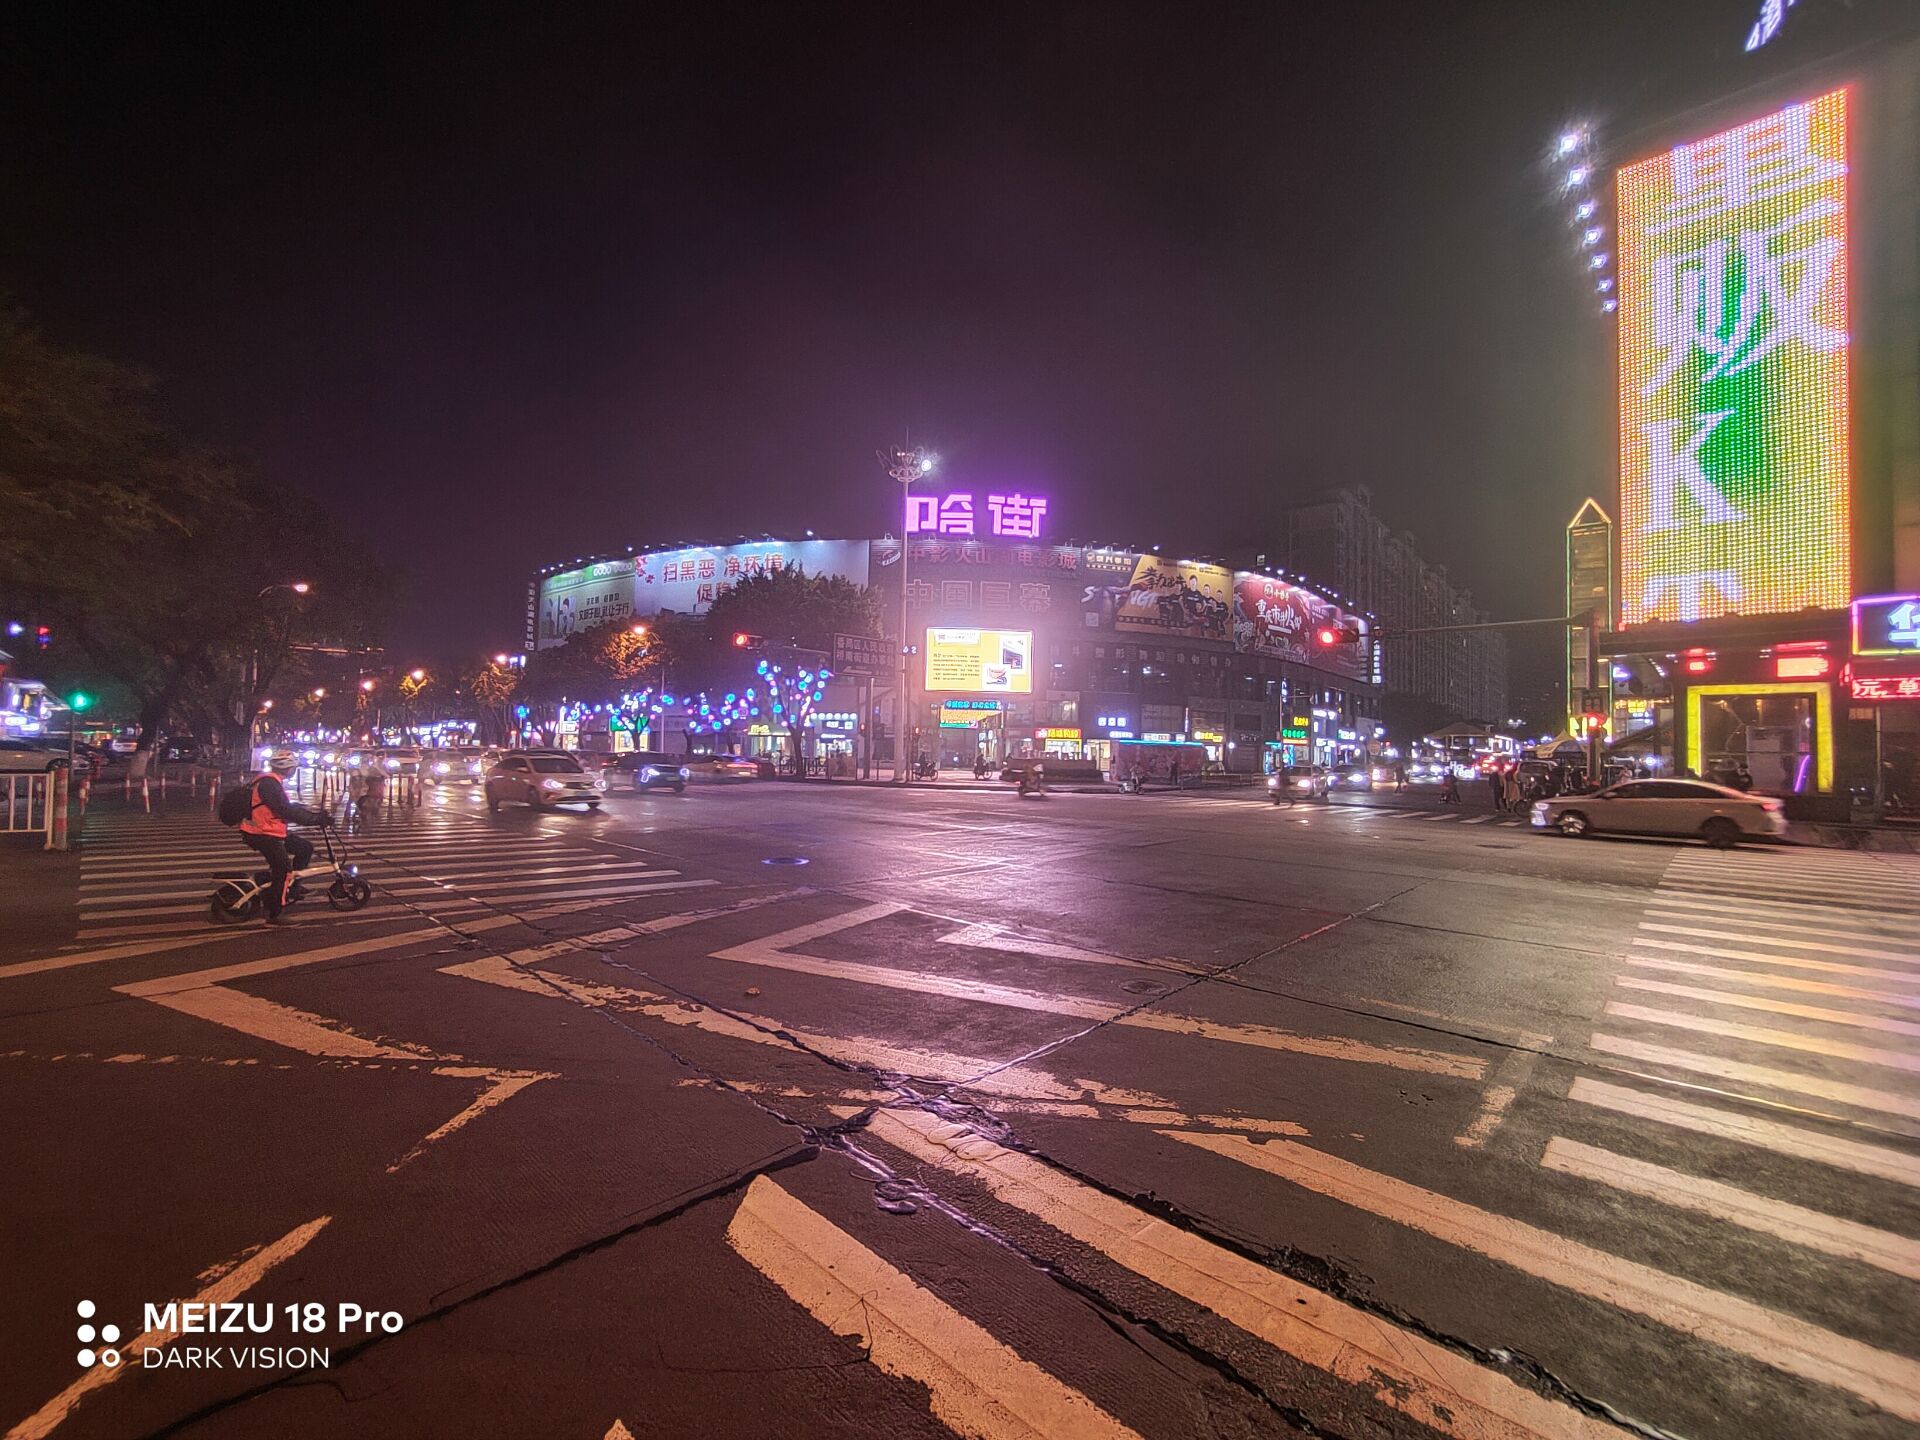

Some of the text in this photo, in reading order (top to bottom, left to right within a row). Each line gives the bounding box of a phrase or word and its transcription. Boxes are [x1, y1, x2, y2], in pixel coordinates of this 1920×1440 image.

[664, 553, 785, 584] 扫黑恶 净环境
[905, 578, 1051, 613] 中国巨幕
